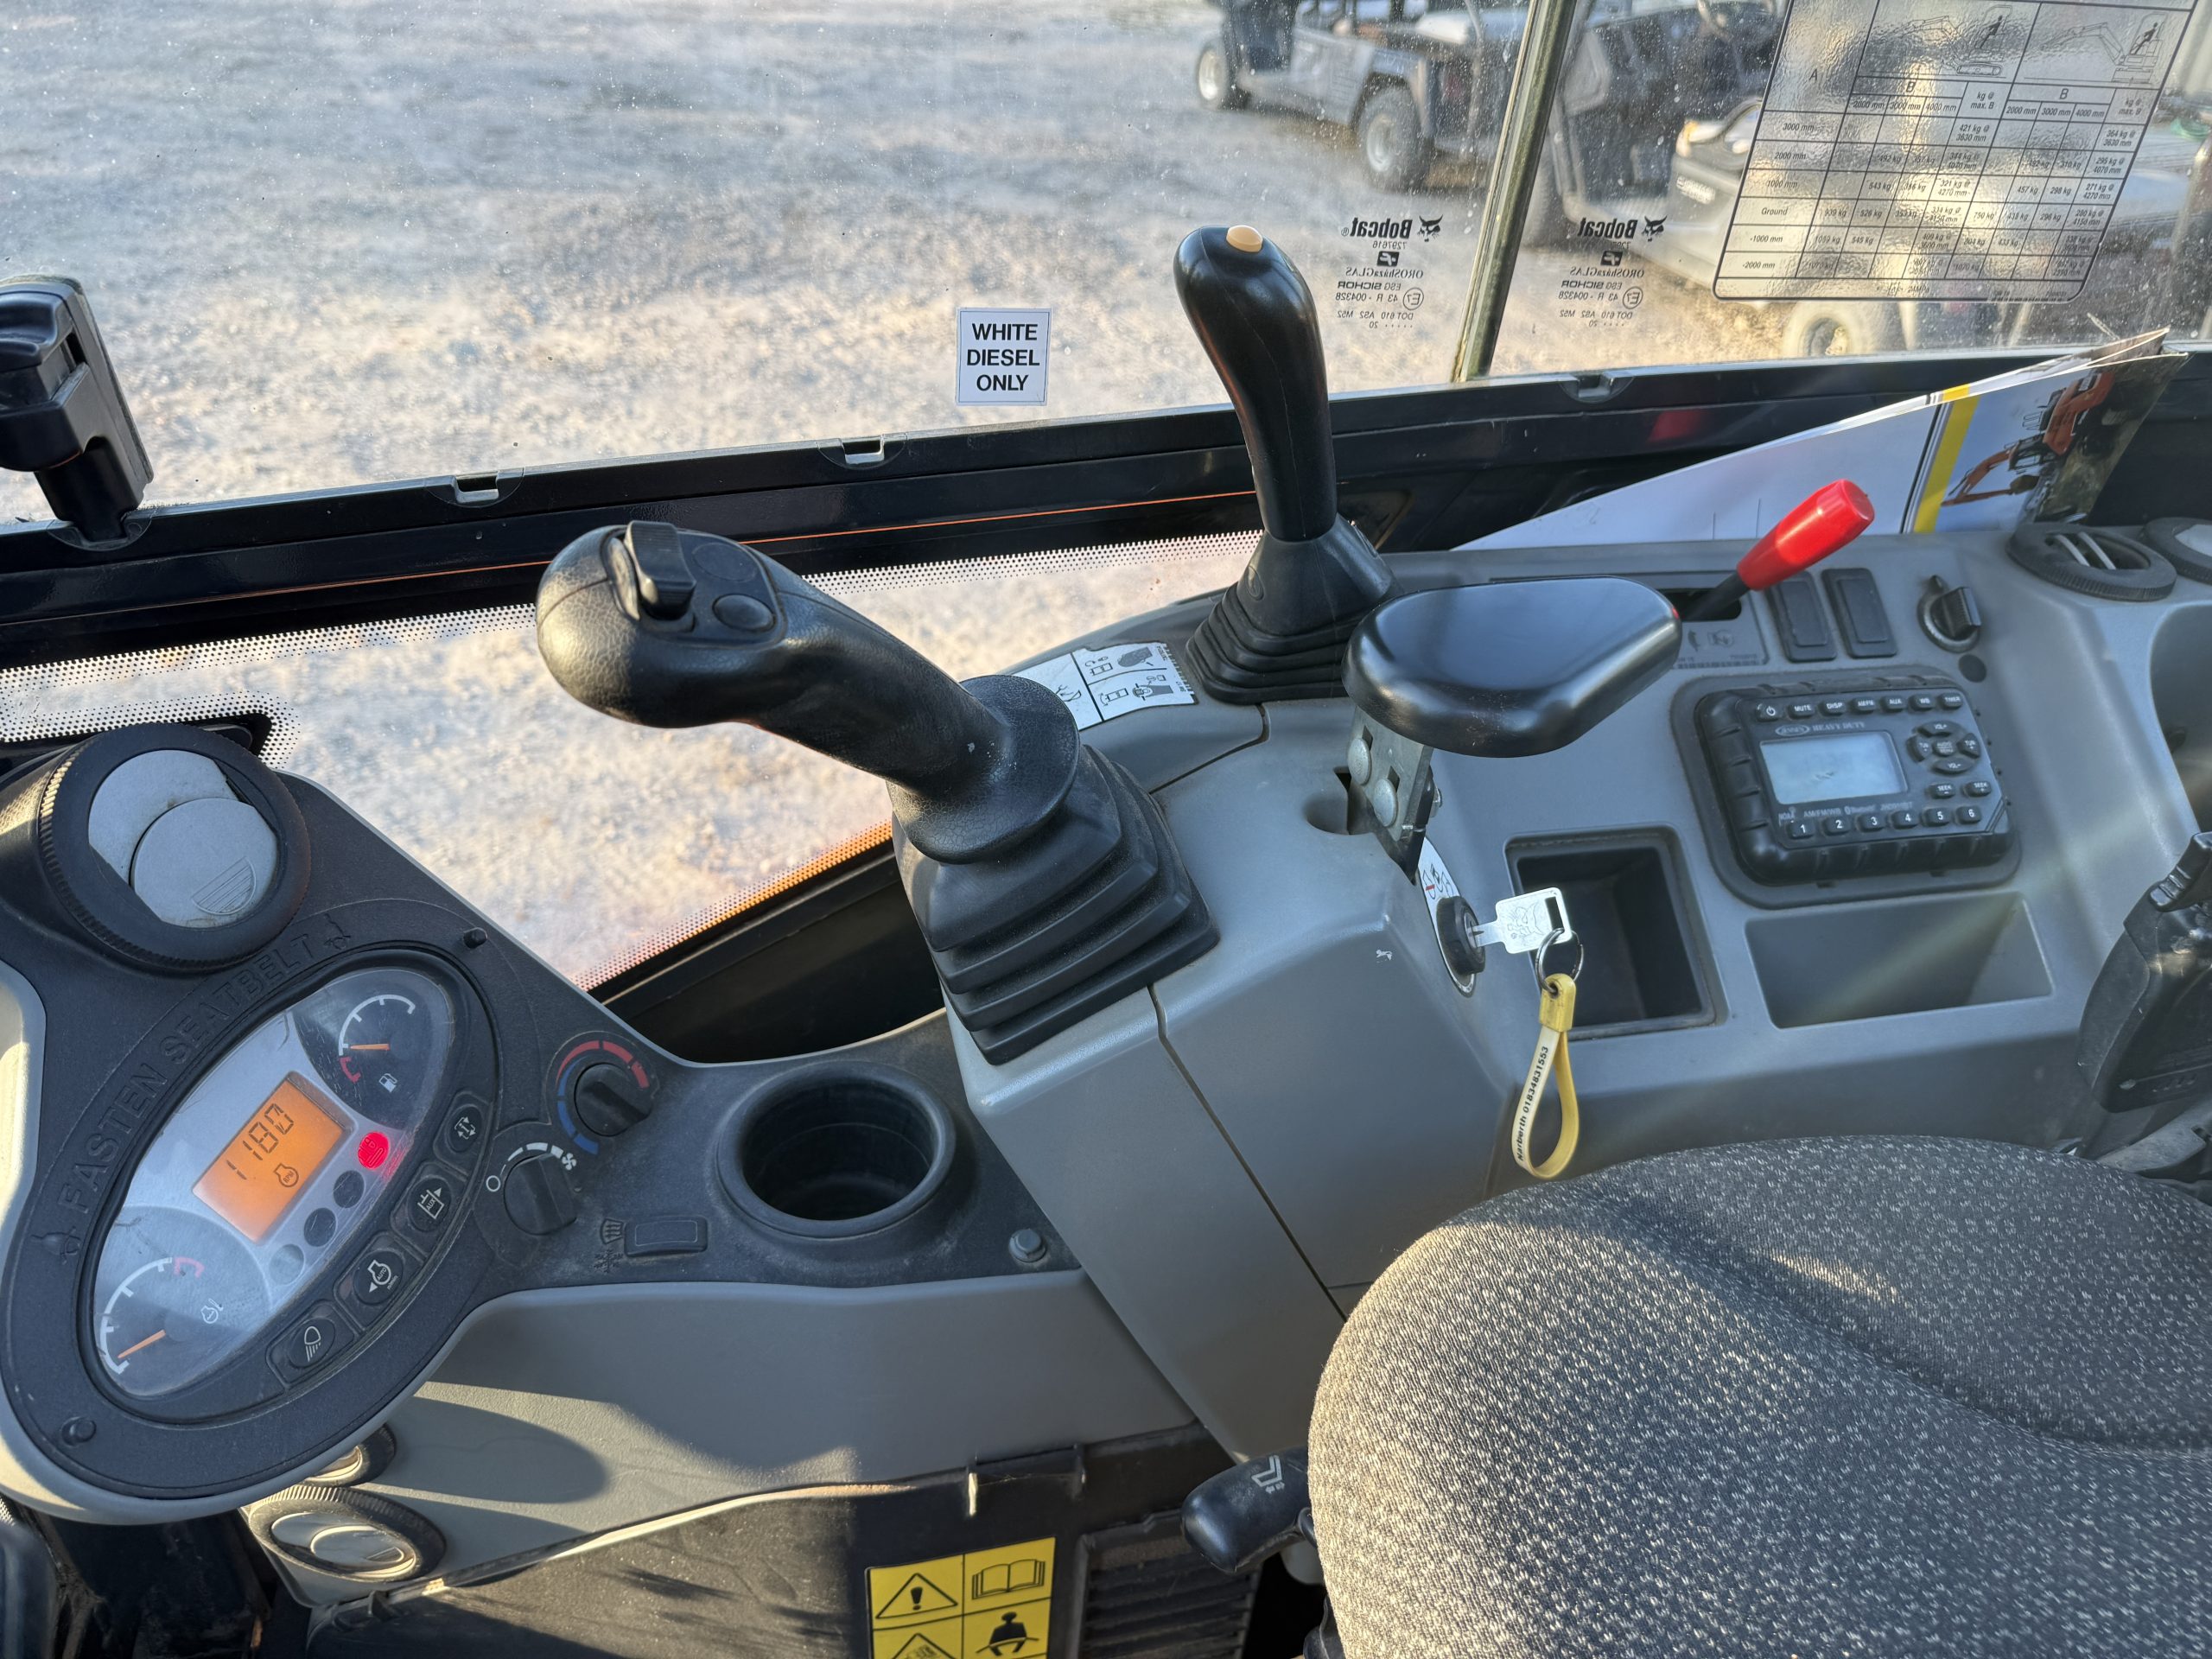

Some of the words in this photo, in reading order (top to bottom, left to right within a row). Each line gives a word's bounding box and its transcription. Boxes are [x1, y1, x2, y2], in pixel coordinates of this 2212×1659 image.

[1905, 81, 1916, 92] B
[1977, 91, 1986, 101] kg
[2059, 88, 2069, 99] B
[1890, 101, 1906, 110] 3000
[2126, 98, 2134, 106] kg
[1971, 124, 1981, 135] kg
[1955, 133, 1973, 142] 3630
[2119, 130, 2127, 140] kg
[1890, 156, 1901, 165] kg
[2074, 162, 2082, 170] kg
[1880, 182, 1891, 192] kg
[1917, 184, 1926, 193] kg
[1761, 207, 1788, 216] Ground
[1835, 209, 1847, 219] kg
[1872, 209, 1882, 219] kg
[2020, 213, 2029, 221] kg
[2052, 213, 2062, 222] kg
[1830, 236, 1840, 246] kg
[1863, 237, 1874, 246] kg
[2011, 239, 2019, 248] kg
[971, 323, 1038, 340] WHITE
[967, 349, 1040, 366] DIESEL
[976, 374, 1029, 391] ONLY
[1813, 722, 1840, 732] HEAVY
[1905, 813, 1911, 822] 4
[1938, 811, 1943, 820] 5
[1969, 809, 1975, 817] 6
[1835, 820, 1843, 829] 2
[1871, 817, 1878, 825] 3
[1800, 824, 1806, 833] 1
[57, 1062, 168, 1214] FASTEN
[160, 932, 315, 1066] SEATBELT
[1516, 1116, 1526, 1161] Narberth
[1523, 1046, 1548, 1114] 01834831553
[283, 1171, 295, 1184] RPM
[426, 1198, 435, 1211] AUX
[377, 1267, 387, 1281] AUTO
